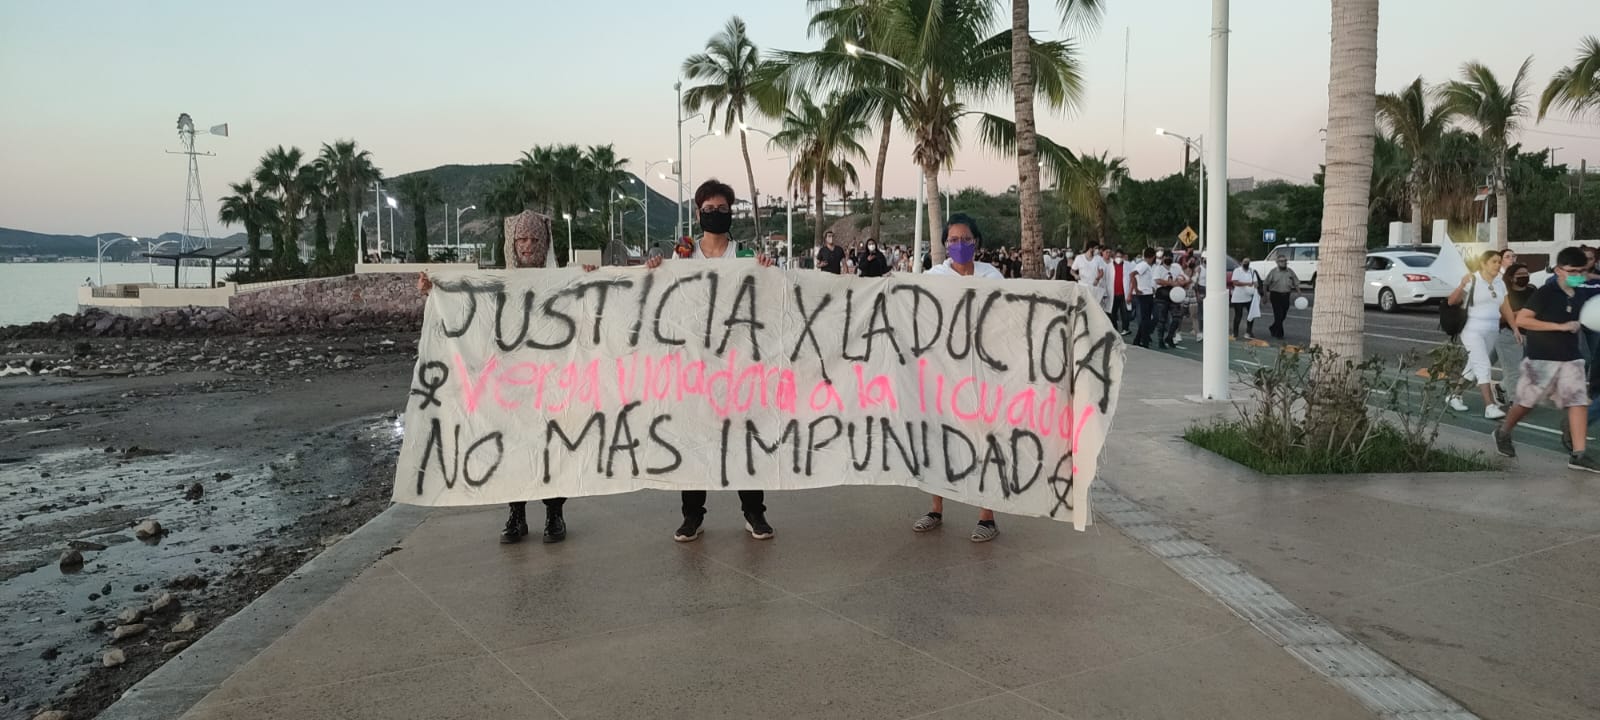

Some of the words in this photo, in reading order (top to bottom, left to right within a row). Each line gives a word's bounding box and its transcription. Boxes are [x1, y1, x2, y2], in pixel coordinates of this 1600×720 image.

[434, 272, 764, 361] JUSTICIA
[790, 285, 832, 384] X
[454, 352, 601, 412] Verga
[809, 380, 844, 413] a
[854, 364, 897, 411] la
[416, 417, 504, 495] NO
[544, 401, 682, 483] MÁS
[721, 415, 1043, 499] IMPUNIDAD
